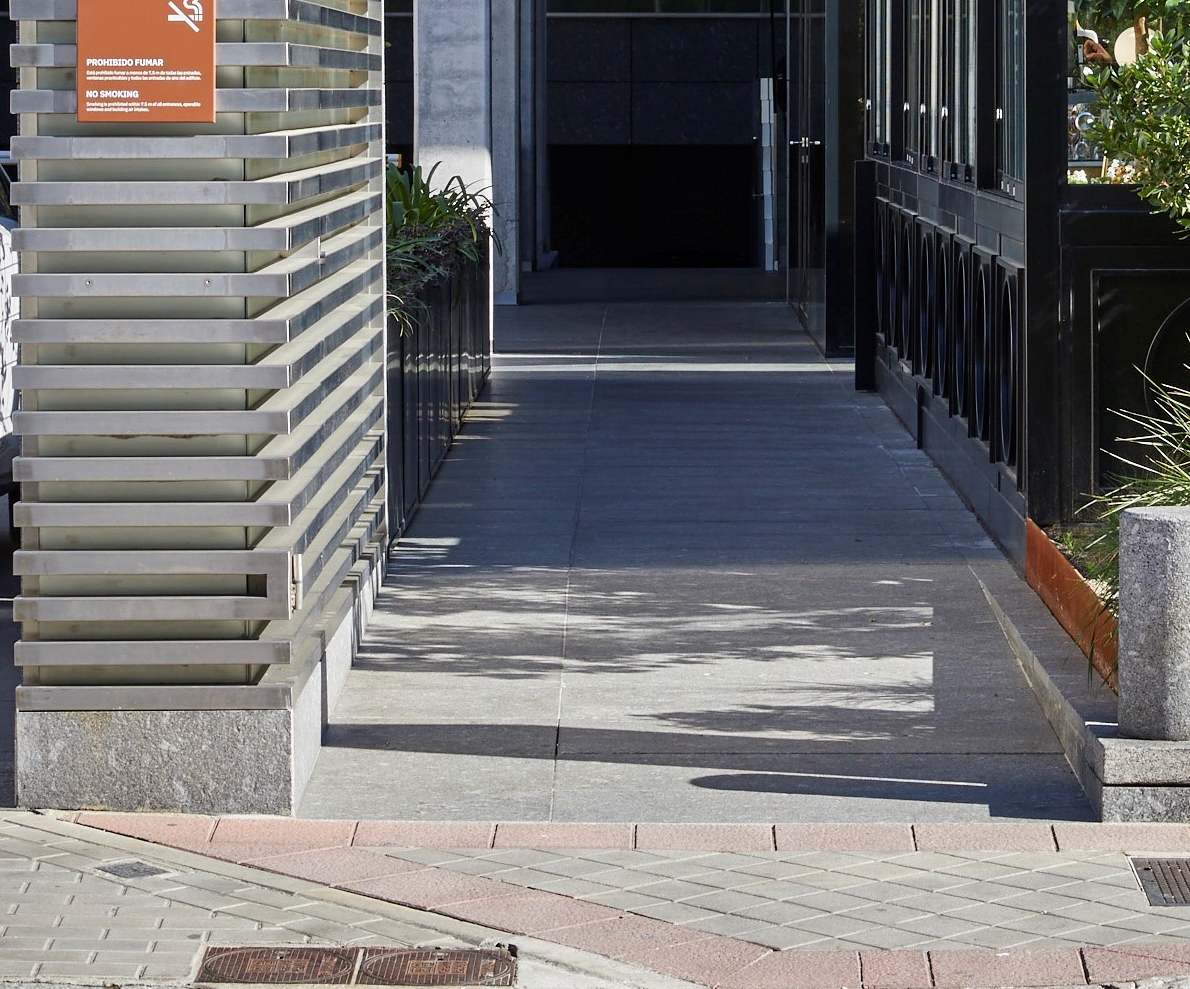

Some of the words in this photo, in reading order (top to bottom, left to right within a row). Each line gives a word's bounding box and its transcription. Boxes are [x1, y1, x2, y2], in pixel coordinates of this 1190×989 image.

[86, 58, 134, 67] PROHIBIDO
[134, 58, 164, 67] FUMAR
[85, 90, 99, 98] NO
[99, 90, 139, 98] SMOKING
